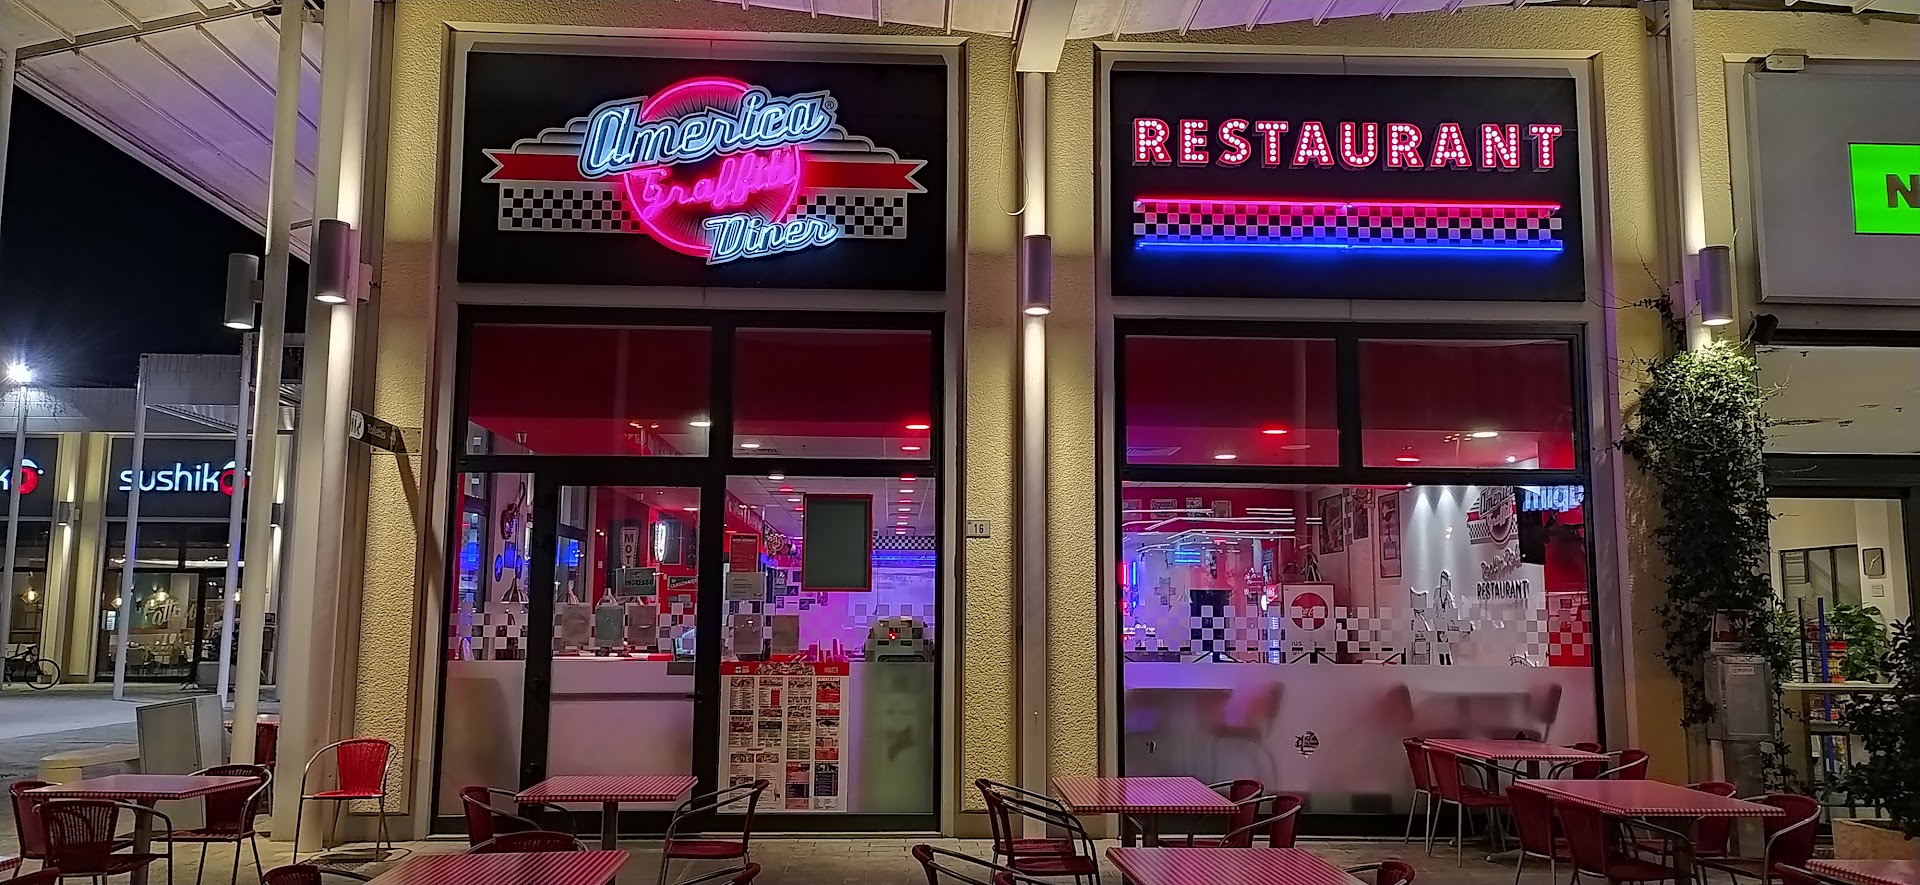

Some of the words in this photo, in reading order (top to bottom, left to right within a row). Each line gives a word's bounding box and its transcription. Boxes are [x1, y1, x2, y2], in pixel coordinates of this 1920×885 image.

[583, 91, 829, 171] America
[1132, 117, 1564, 171] RESTAURANT
[629, 148, 797, 218] Graffiti
[703, 215, 838, 260] Diner
[973, 523, 985, 534] 16
[1476, 580, 1528, 600] RESTAURANT
